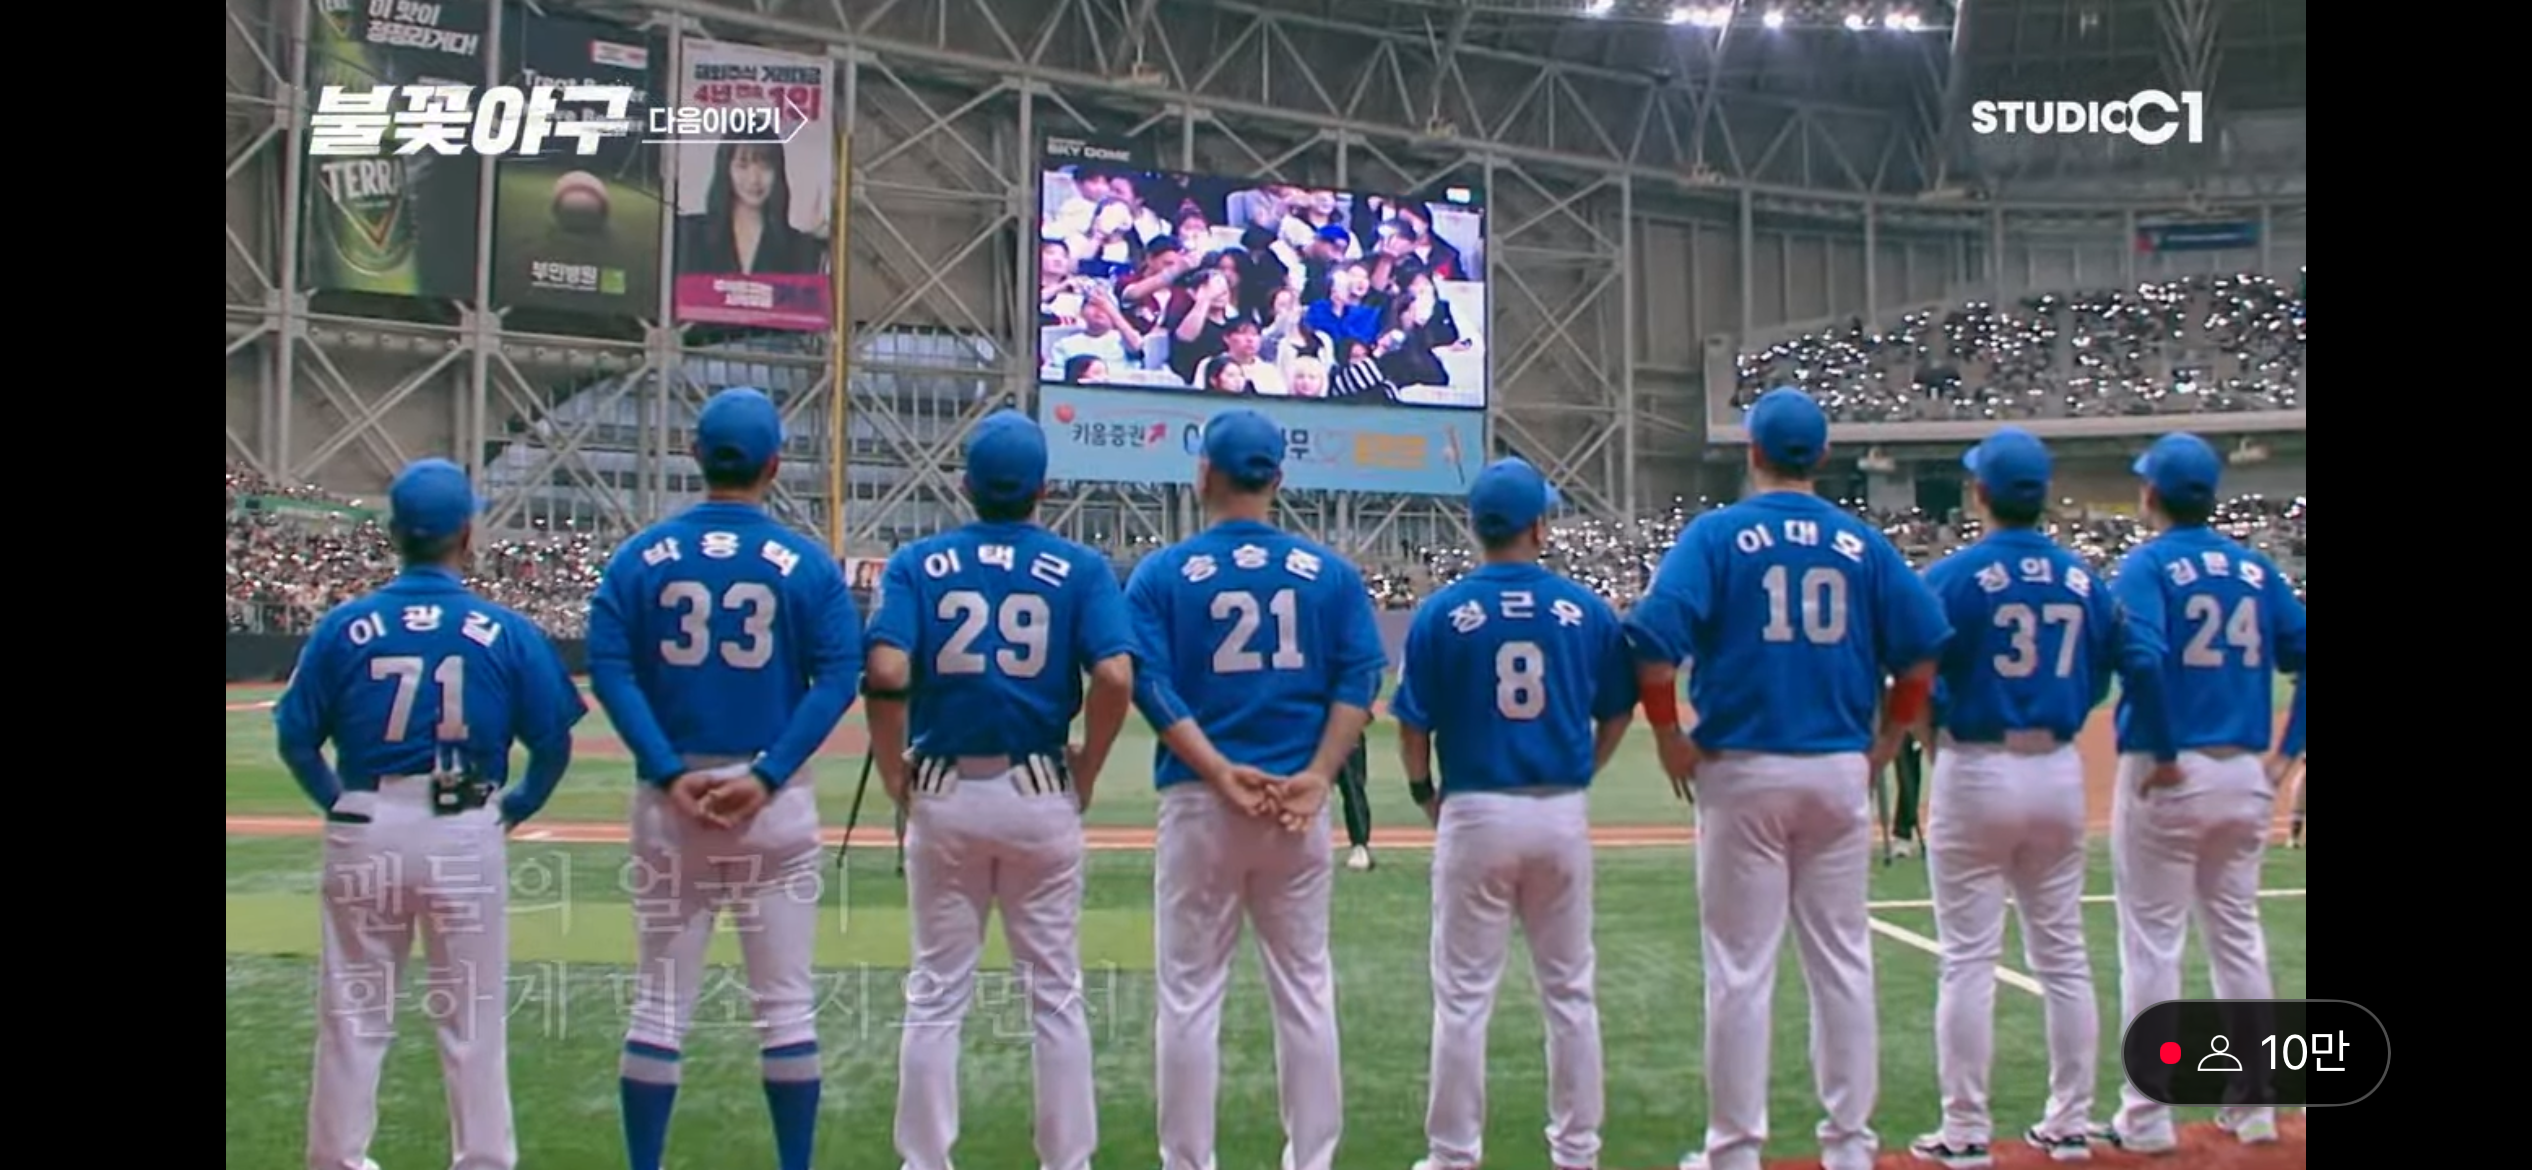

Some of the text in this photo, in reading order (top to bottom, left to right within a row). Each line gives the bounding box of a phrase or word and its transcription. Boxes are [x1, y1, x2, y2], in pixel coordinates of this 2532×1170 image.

[1072, 422, 1146, 448] 키움증권
[642, 530, 800, 578] 박용택
[923, 544, 1071, 588] 이택근
[1736, 519, 1866, 563] 이대호
[348, 603, 500, 648] 이광길
[658, 580, 777, 670] 33
[936, 590, 1050, 678] 29
[1210, 588, 1305, 674] 21
[1447, 590, 1585, 634] 정근우
[1762, 564, 1848, 644] 10
[1992, 602, 2085, 679] 37
[2181, 593, 2263, 668] 24
[370, 655, 469, 743] 71
[1495, 640, 1545, 721] 8
